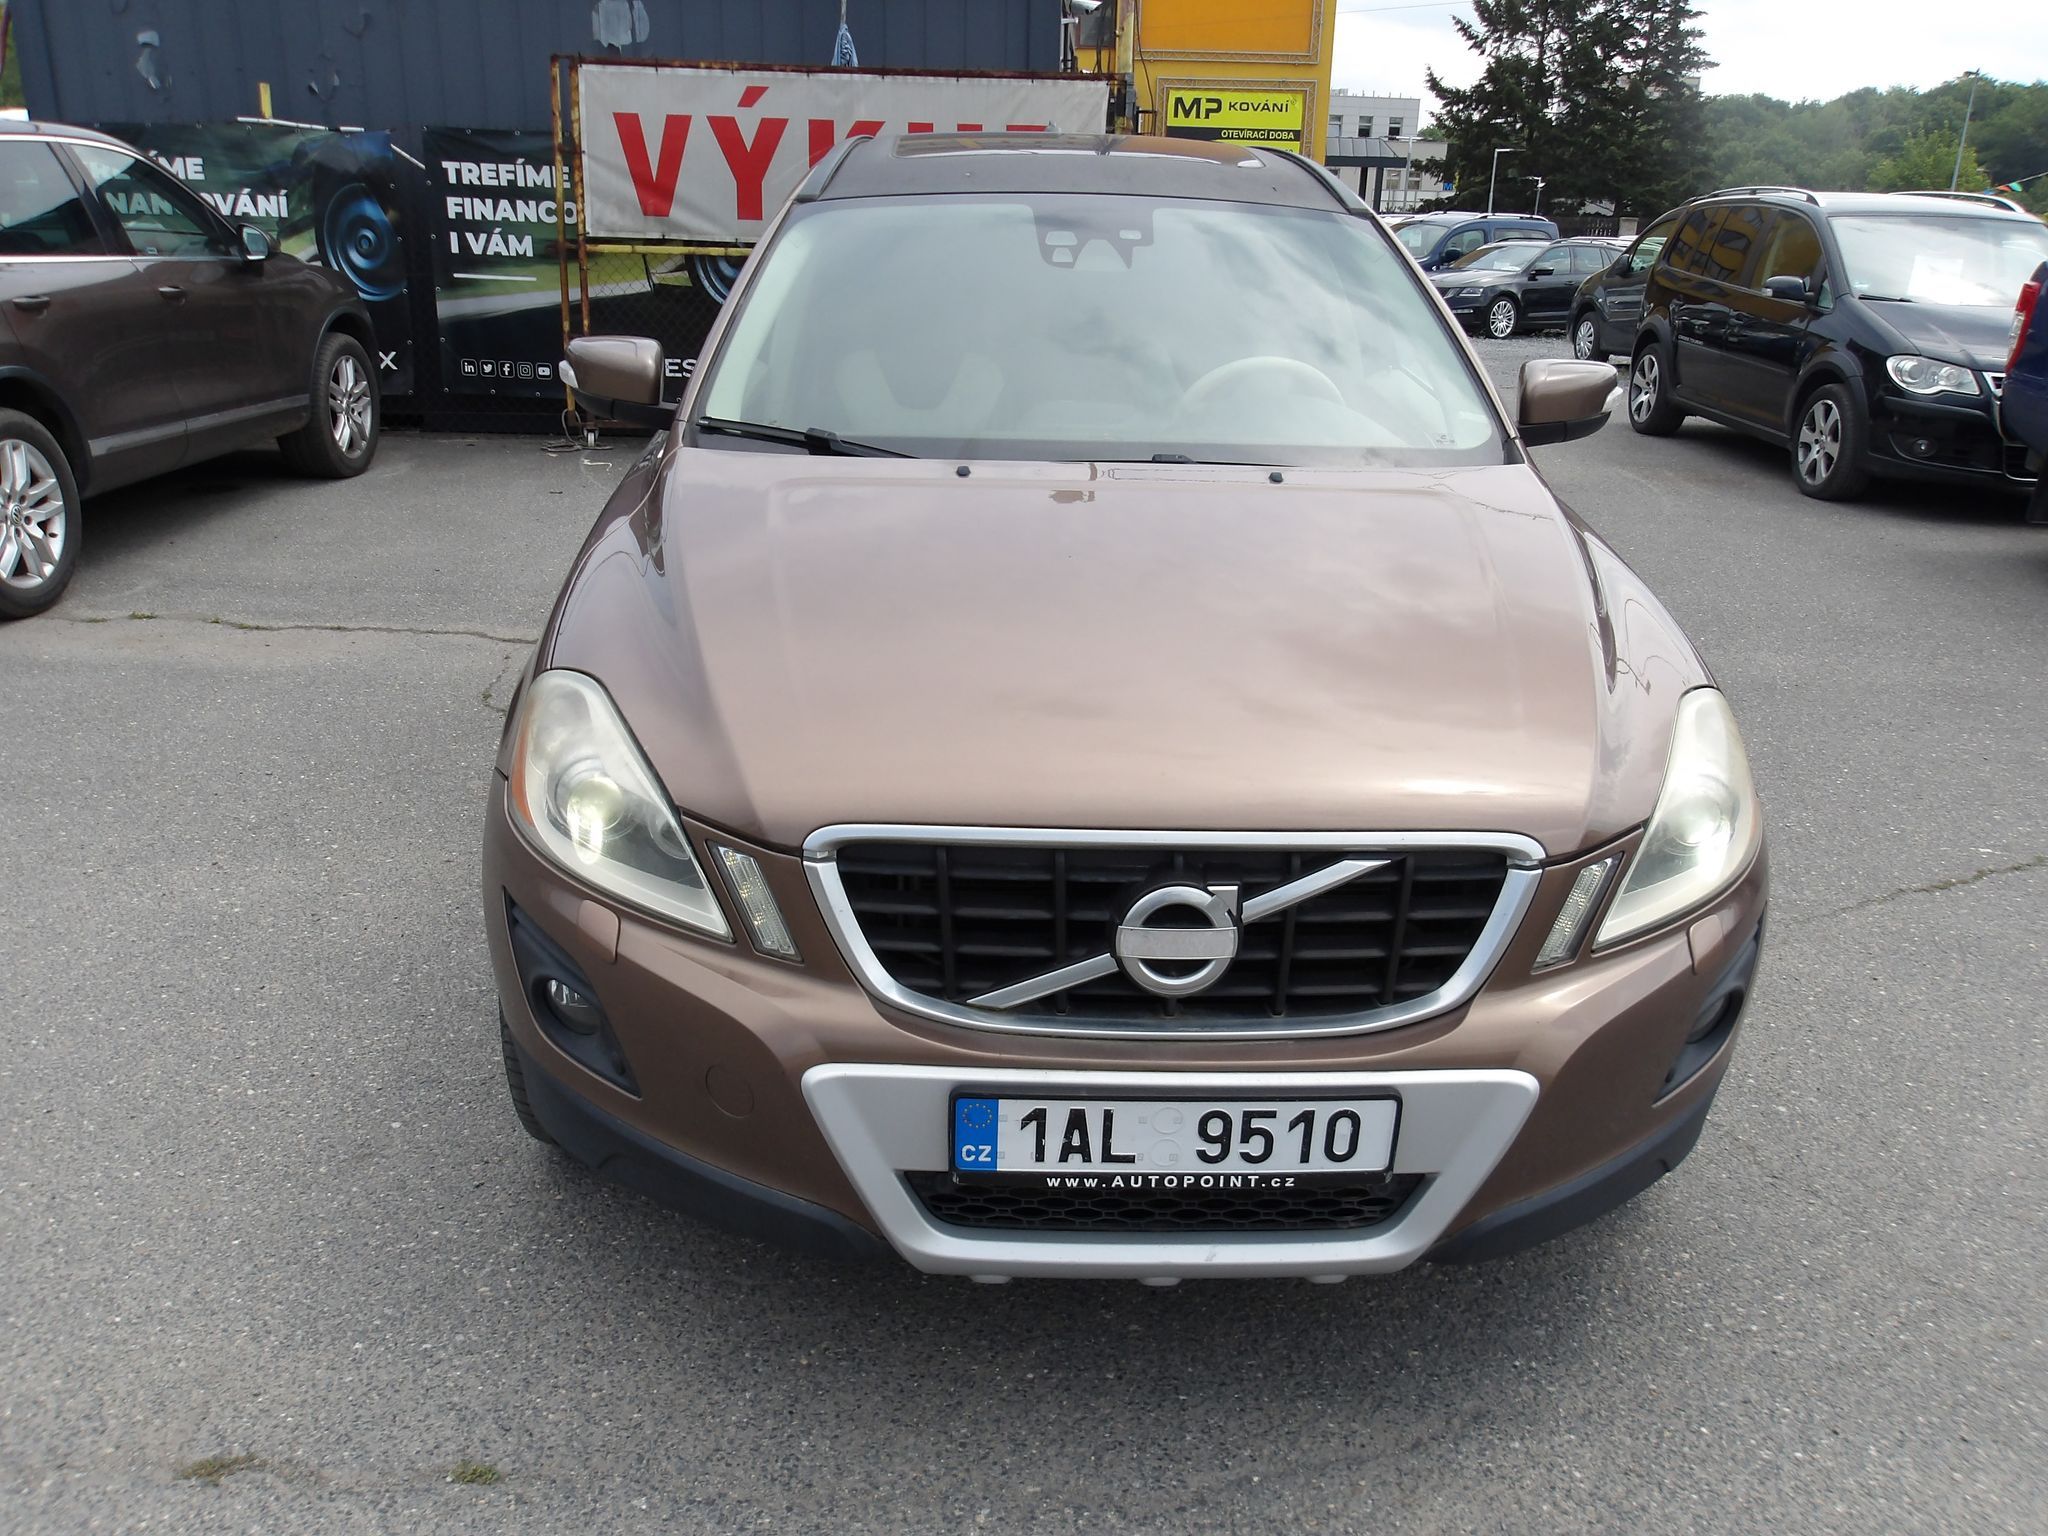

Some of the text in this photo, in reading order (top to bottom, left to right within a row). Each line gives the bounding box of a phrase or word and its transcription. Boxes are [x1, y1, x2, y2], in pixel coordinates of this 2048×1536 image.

[1173, 96, 1289, 119] MP KOVÁNÍ
[1221, 128, 1295, 140] OTEVÍRACÍ DOBA
[441, 158, 571, 189] TREFÍME
[450, 228, 534, 257] I VÁM
[1020, 1107, 1361, 1164] 1AL 9510
[961, 1144, 992, 1162] CZ
[1046, 1175, 1295, 1188] www.AUTOPOINT.cz
